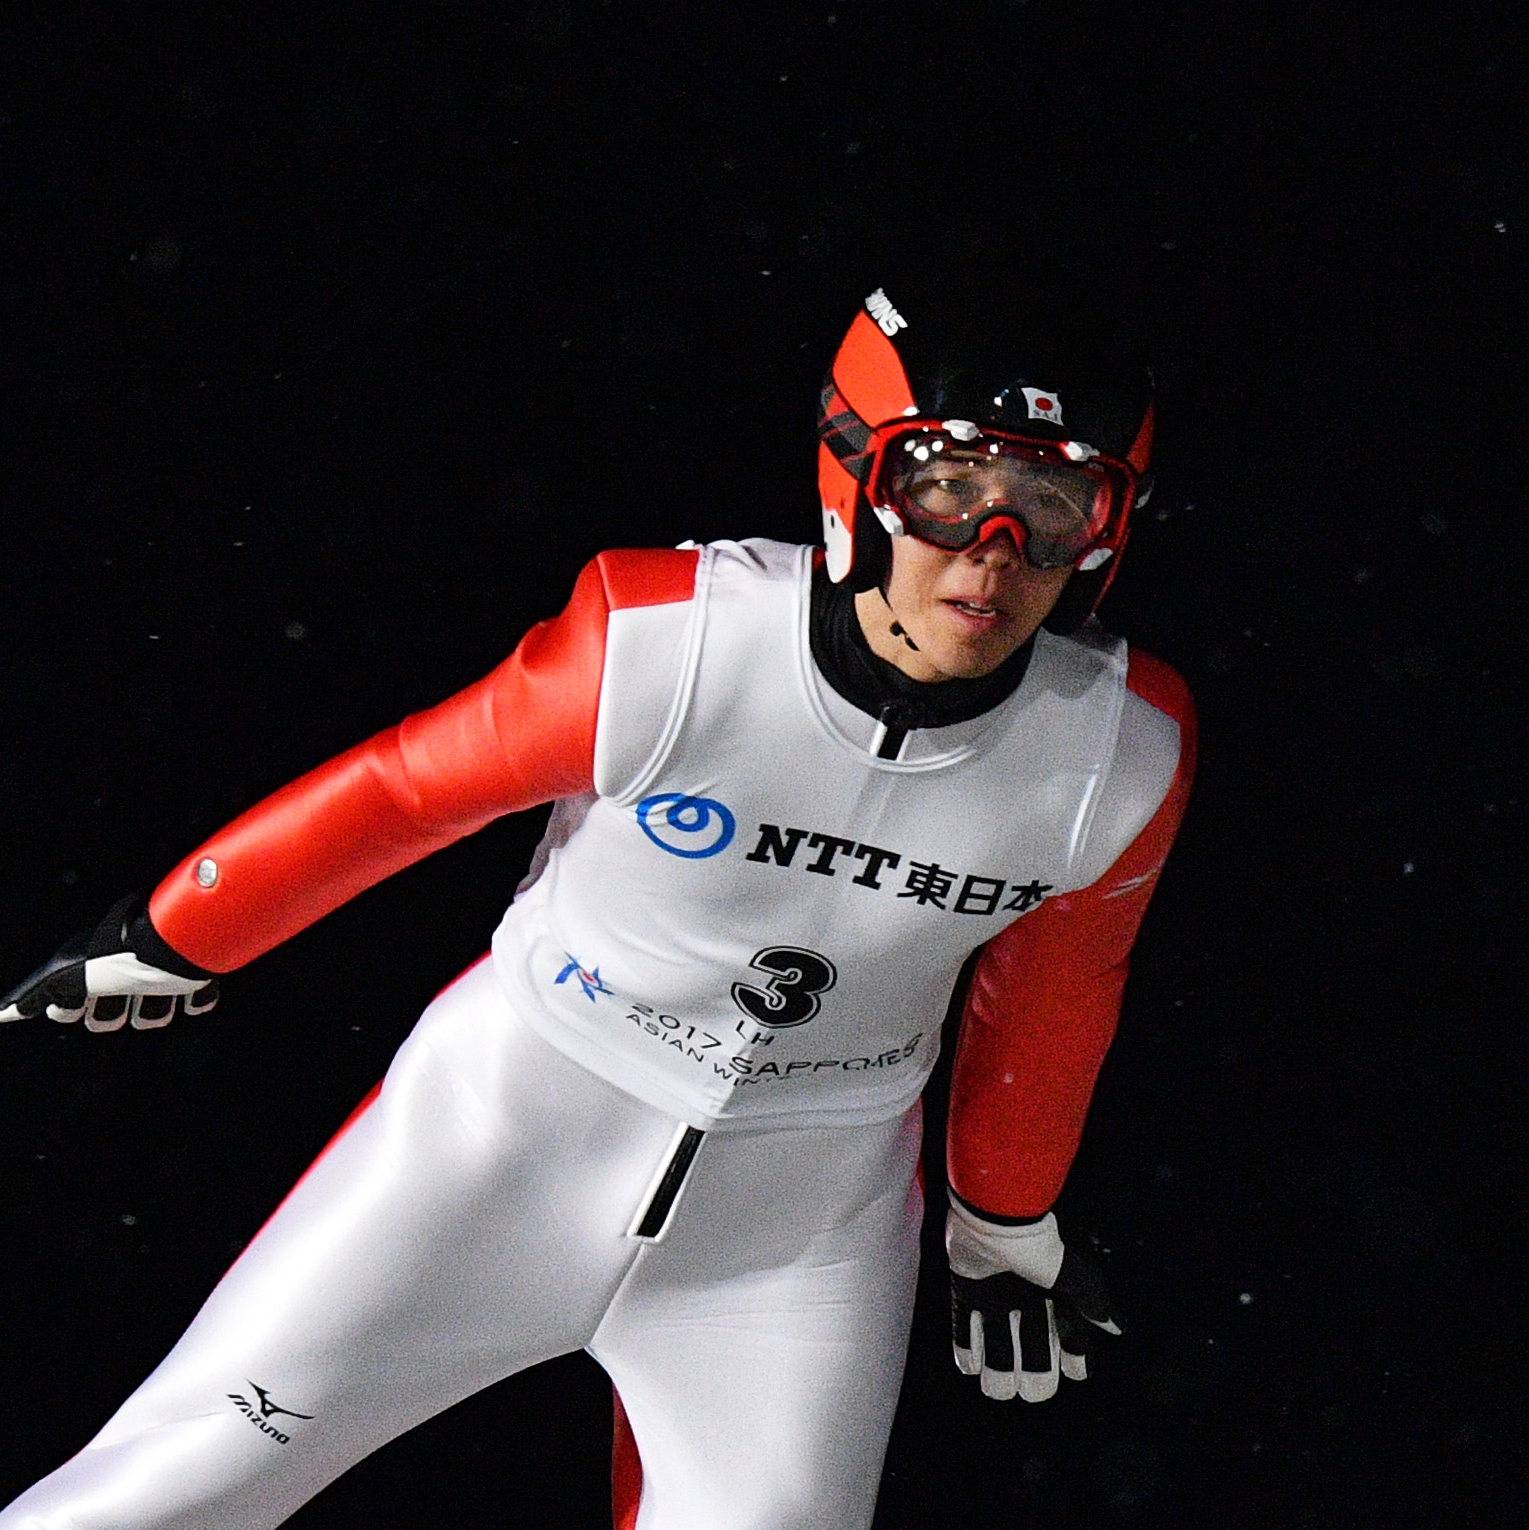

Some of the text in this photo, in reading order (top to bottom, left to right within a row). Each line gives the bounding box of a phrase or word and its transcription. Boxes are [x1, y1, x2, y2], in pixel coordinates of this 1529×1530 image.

[730, 945, 838, 1029] 3
[626, 1012, 705, 1063] ASIAN
[631, 1002, 723, 1051] 2017
[735, 1019, 776, 1046] LH
